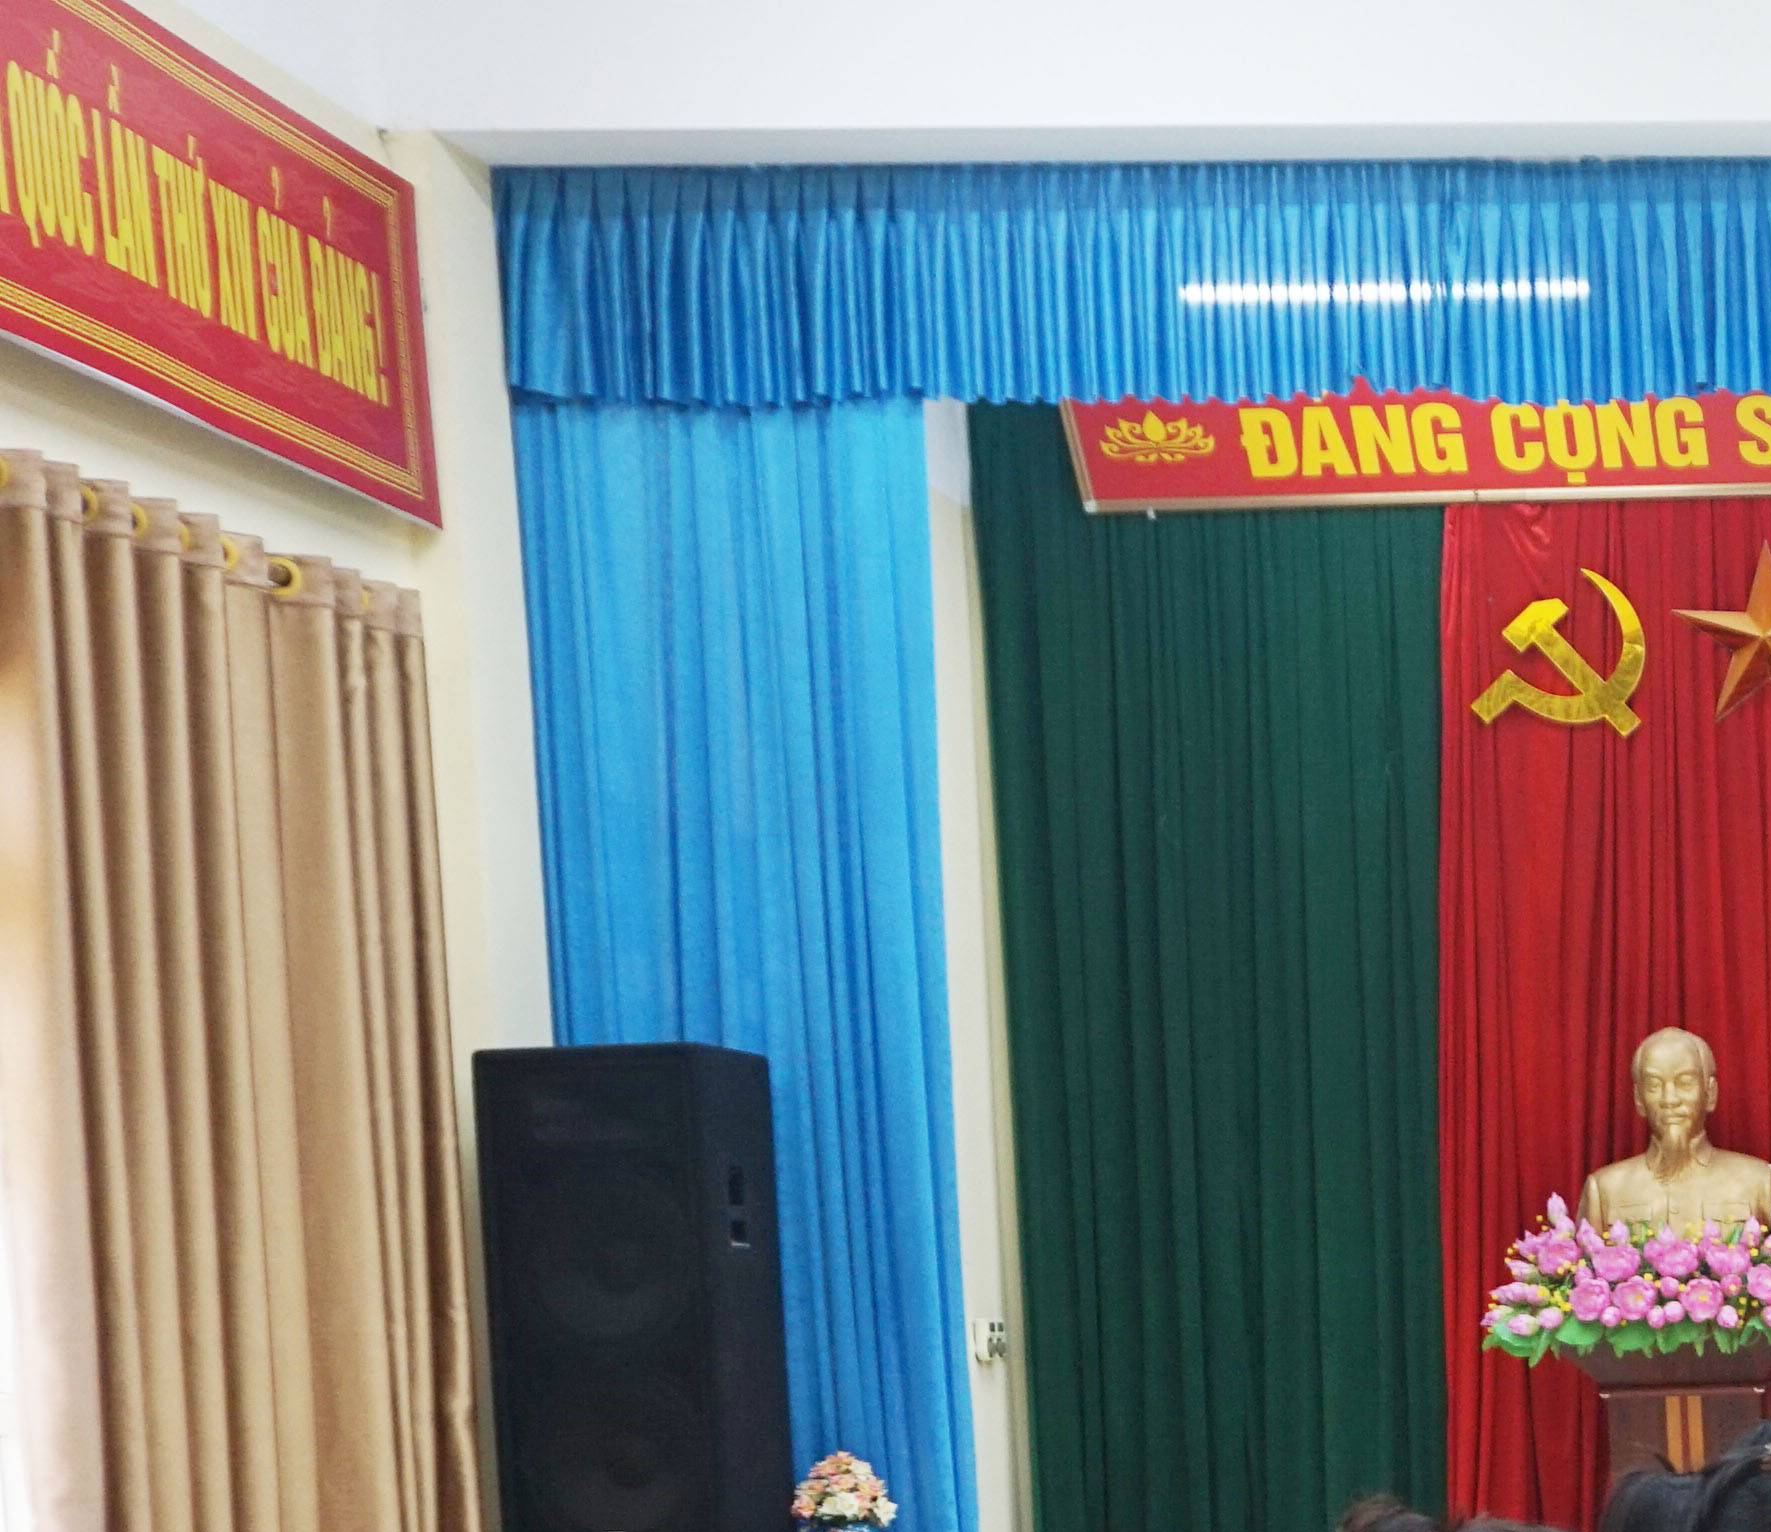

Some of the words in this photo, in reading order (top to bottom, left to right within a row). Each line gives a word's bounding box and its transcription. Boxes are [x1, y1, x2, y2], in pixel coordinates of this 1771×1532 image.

[7, 28, 95, 256] QUỐC
[152, 134, 213, 318] THỨ
[208, 178, 258, 341] XIV
[257, 166, 315, 369] CỦA
[308, 196, 389, 406] ĐẢNG!
